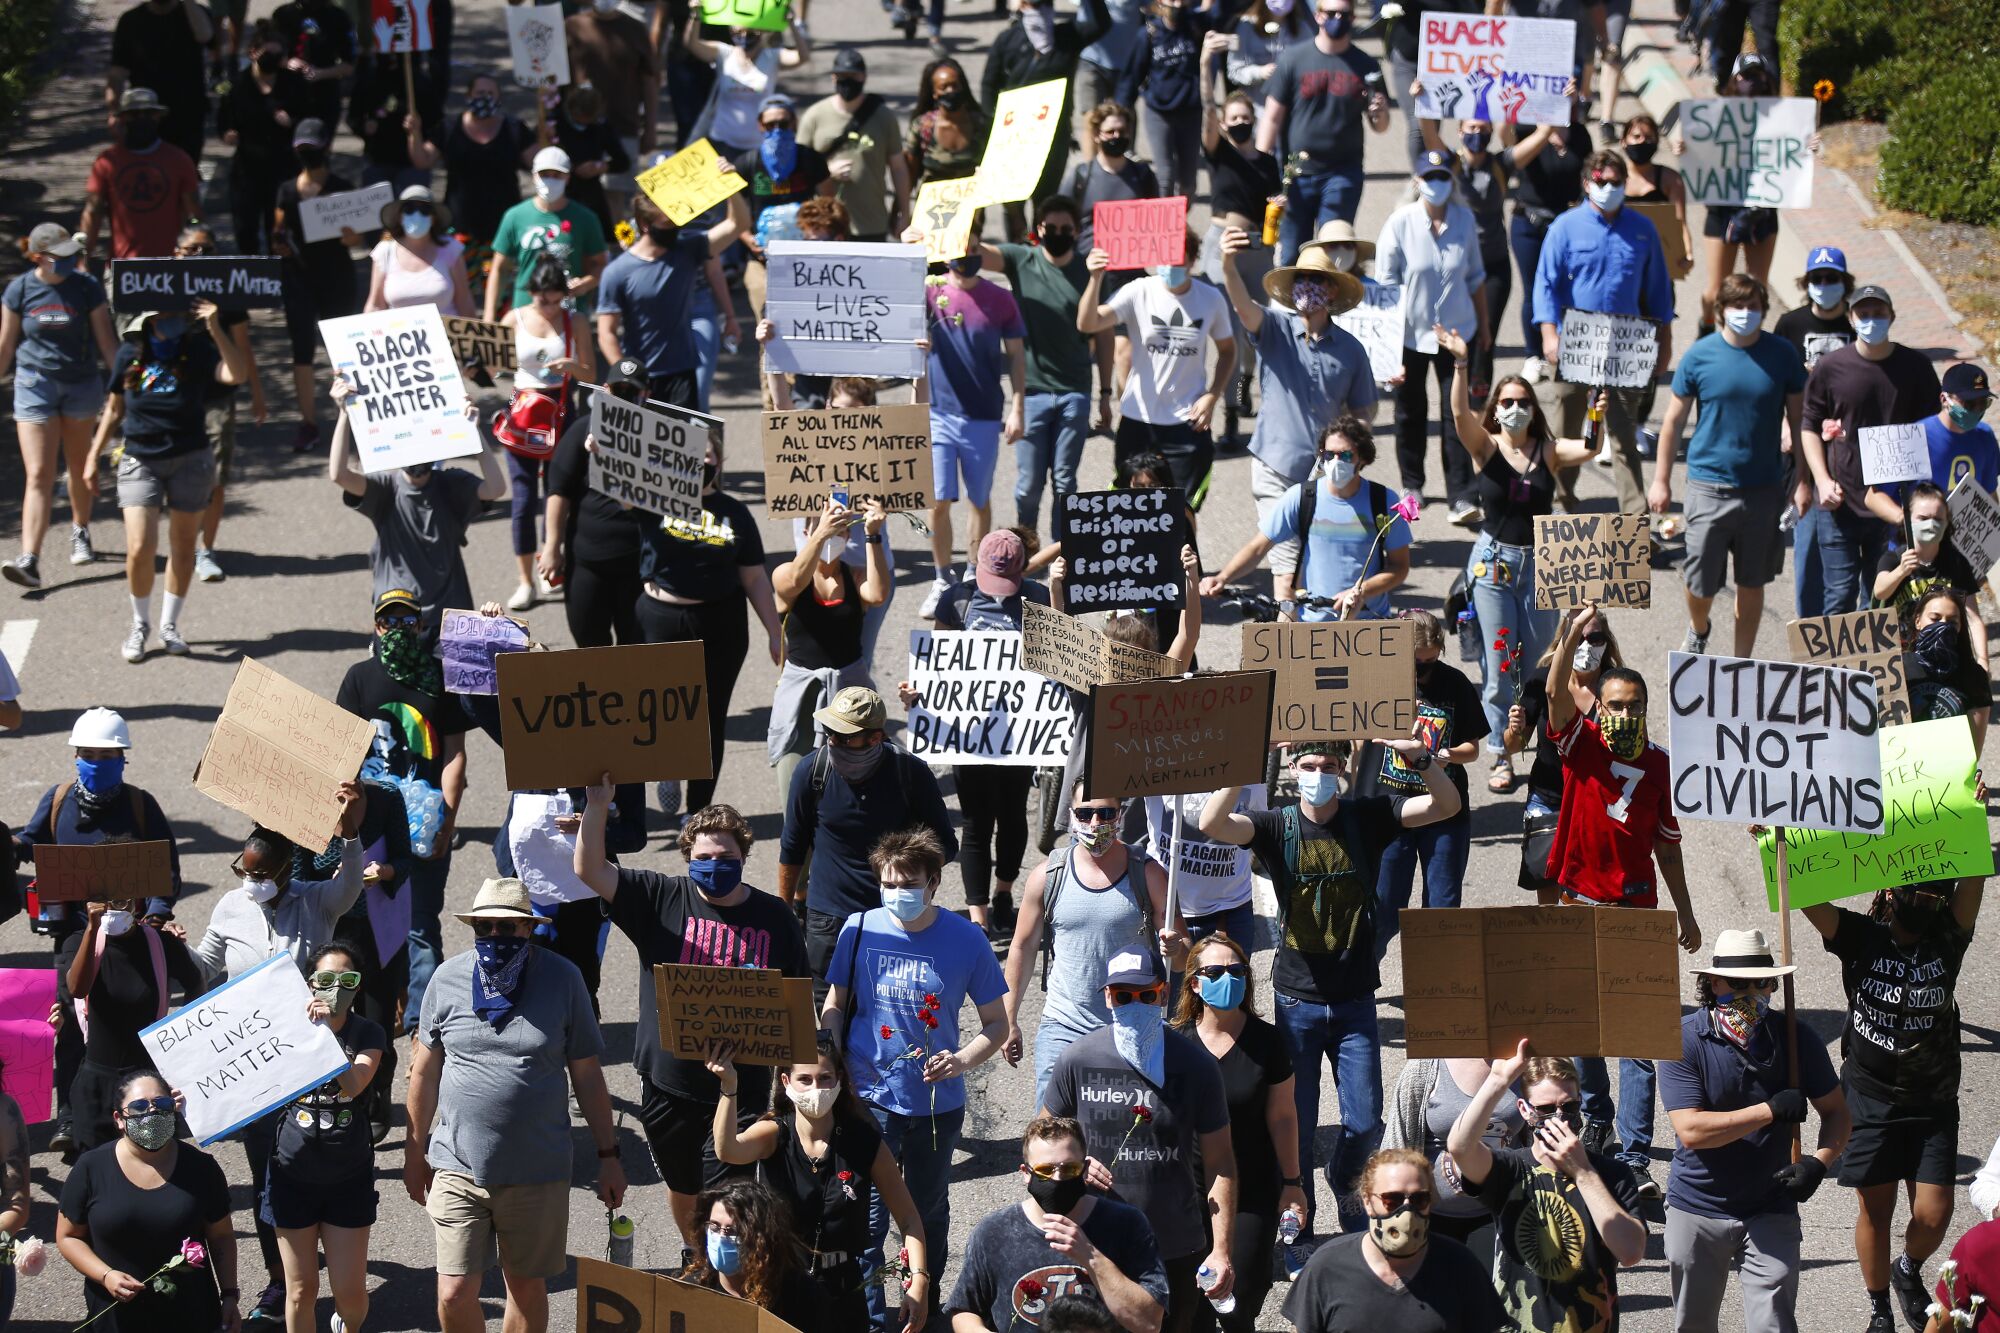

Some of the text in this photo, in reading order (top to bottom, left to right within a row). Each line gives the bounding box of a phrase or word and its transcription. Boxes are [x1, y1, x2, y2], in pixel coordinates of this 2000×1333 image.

[1426, 19, 1507, 47] BLACK
[1426, 51, 1505, 77] LIVES
[1690, 101, 1758, 142] SAY
[1714, 137, 1802, 169] THEIR
[641, 150, 705, 193] DEFUND
[1680, 168, 1783, 203] NAMES
[1096, 203, 1182, 234] NO JUSTICE
[1097, 235, 1180, 265] NO PEACE
[121, 269, 175, 295] BLACK
[793, 261, 867, 289] BLACK
[816, 293, 890, 316] LIVES
[793, 320, 882, 341] MATTER
[1565, 322, 1632, 340] WHO DO YOU
[355, 329, 431, 366] BLACK
[1565, 341, 1654, 354] WHEN YOUR OWN
[1561, 352, 1637, 377] POLICE HURTING
[364, 385, 447, 422] MATTER
[601, 402, 686, 448] WHO DO
[769, 414, 883, 431] IF YOU THINK
[1866, 425, 1922, 445] RACISM
[598, 425, 704, 478] YOU SERVE?
[783, 435, 927, 450] ALL LIVES MATTER
[1876, 443, 1905, 456] IS THE
[594, 452, 699, 498] WHO DO YOU
[789, 458, 917, 483] ACT LIKE IT
[1873, 462, 1922, 479] PANDEMIC
[602, 471, 700, 522] PROTECT?
[1066, 489, 1167, 514] Respect
[1960, 483, 1972, 497] IF
[1069, 513, 1174, 536] Existence
[1541, 516, 1600, 544] HOW
[1956, 504, 1994, 544] ANGRY
[1102, 538, 1135, 554] or
[1559, 539, 1636, 563] MANY
[1959, 532, 1977, 555] NOT
[1075, 553, 1158, 575] Expect
[1069, 578, 1179, 604] Resistance
[1547, 581, 1650, 609] FILMED
[456, 615, 516, 639] DIVEST
[1025, 606, 1167, 665] ABUSE IS THE WEAKEST
[1024, 620, 1161, 678] EXPRESSION OF STRENGTH
[1024, 632, 1034, 641] IT
[1041, 636, 1051, 646] IS
[1054, 640, 1098, 667] WEAKNESS
[1252, 626, 1401, 663] SILENCE
[1024, 644, 1105, 684] WHAT YOU OUGHT
[1027, 657, 1082, 685] BUILD AND
[911, 680, 1026, 714] WORKERS
[1106, 685, 1254, 730] STANFORD
[1669, 655, 1877, 737] CITIZENS
[287, 694, 364, 754] Not Asking
[1129, 716, 1201, 736] PROJECT
[1277, 699, 1412, 732] IOLENCE
[287, 717, 348, 766] Permission
[912, 715, 1075, 756] BLACK LIVES
[1113, 728, 1226, 757] MIRRORS
[1716, 722, 1829, 770] NOT
[240, 735, 313, 792] MY BLACK
[1145, 751, 1207, 771] POLICE
[208, 761, 262, 808] TELLING
[1124, 761, 1230, 791] MENTALITY
[1606, 760, 1645, 823] 7
[1673, 763, 1885, 830] CIVILIANS
[43, 847, 140, 871] ENOUGH
[1180, 858, 1236, 878] MACHINE
[1768, 851, 1840, 883] LIVES
[1900, 859, 1960, 882] #BLM
[59, 870, 151, 896] ENOUGH
[1597, 917, 1638, 939] George
[1642, 919, 1677, 937] Floyd
[667, 969, 769, 983] INJUSTICE
[877, 954, 929, 984] PEOPLE
[671, 984, 780, 998] ANYWHERE
[876, 983, 927, 1002] POLITICIANS
[895, 979, 908, 989] OVER
[1907, 986, 1945, 1008] SIZED
[682, 1003, 788, 1021] IS A THREAT
[1903, 1015, 1935, 1030] AND
[156, 1002, 229, 1053] BLACK
[210, 1009, 271, 1053] LIVES
[674, 1019, 784, 1037] TO JUSTICE
[680, 1035, 792, 1060] EVERYWHERE
[196, 1036, 294, 1099] MATTER
[1081, 1086, 1134, 1106] Hurley
[1118, 1146, 1167, 1162] Hurley
